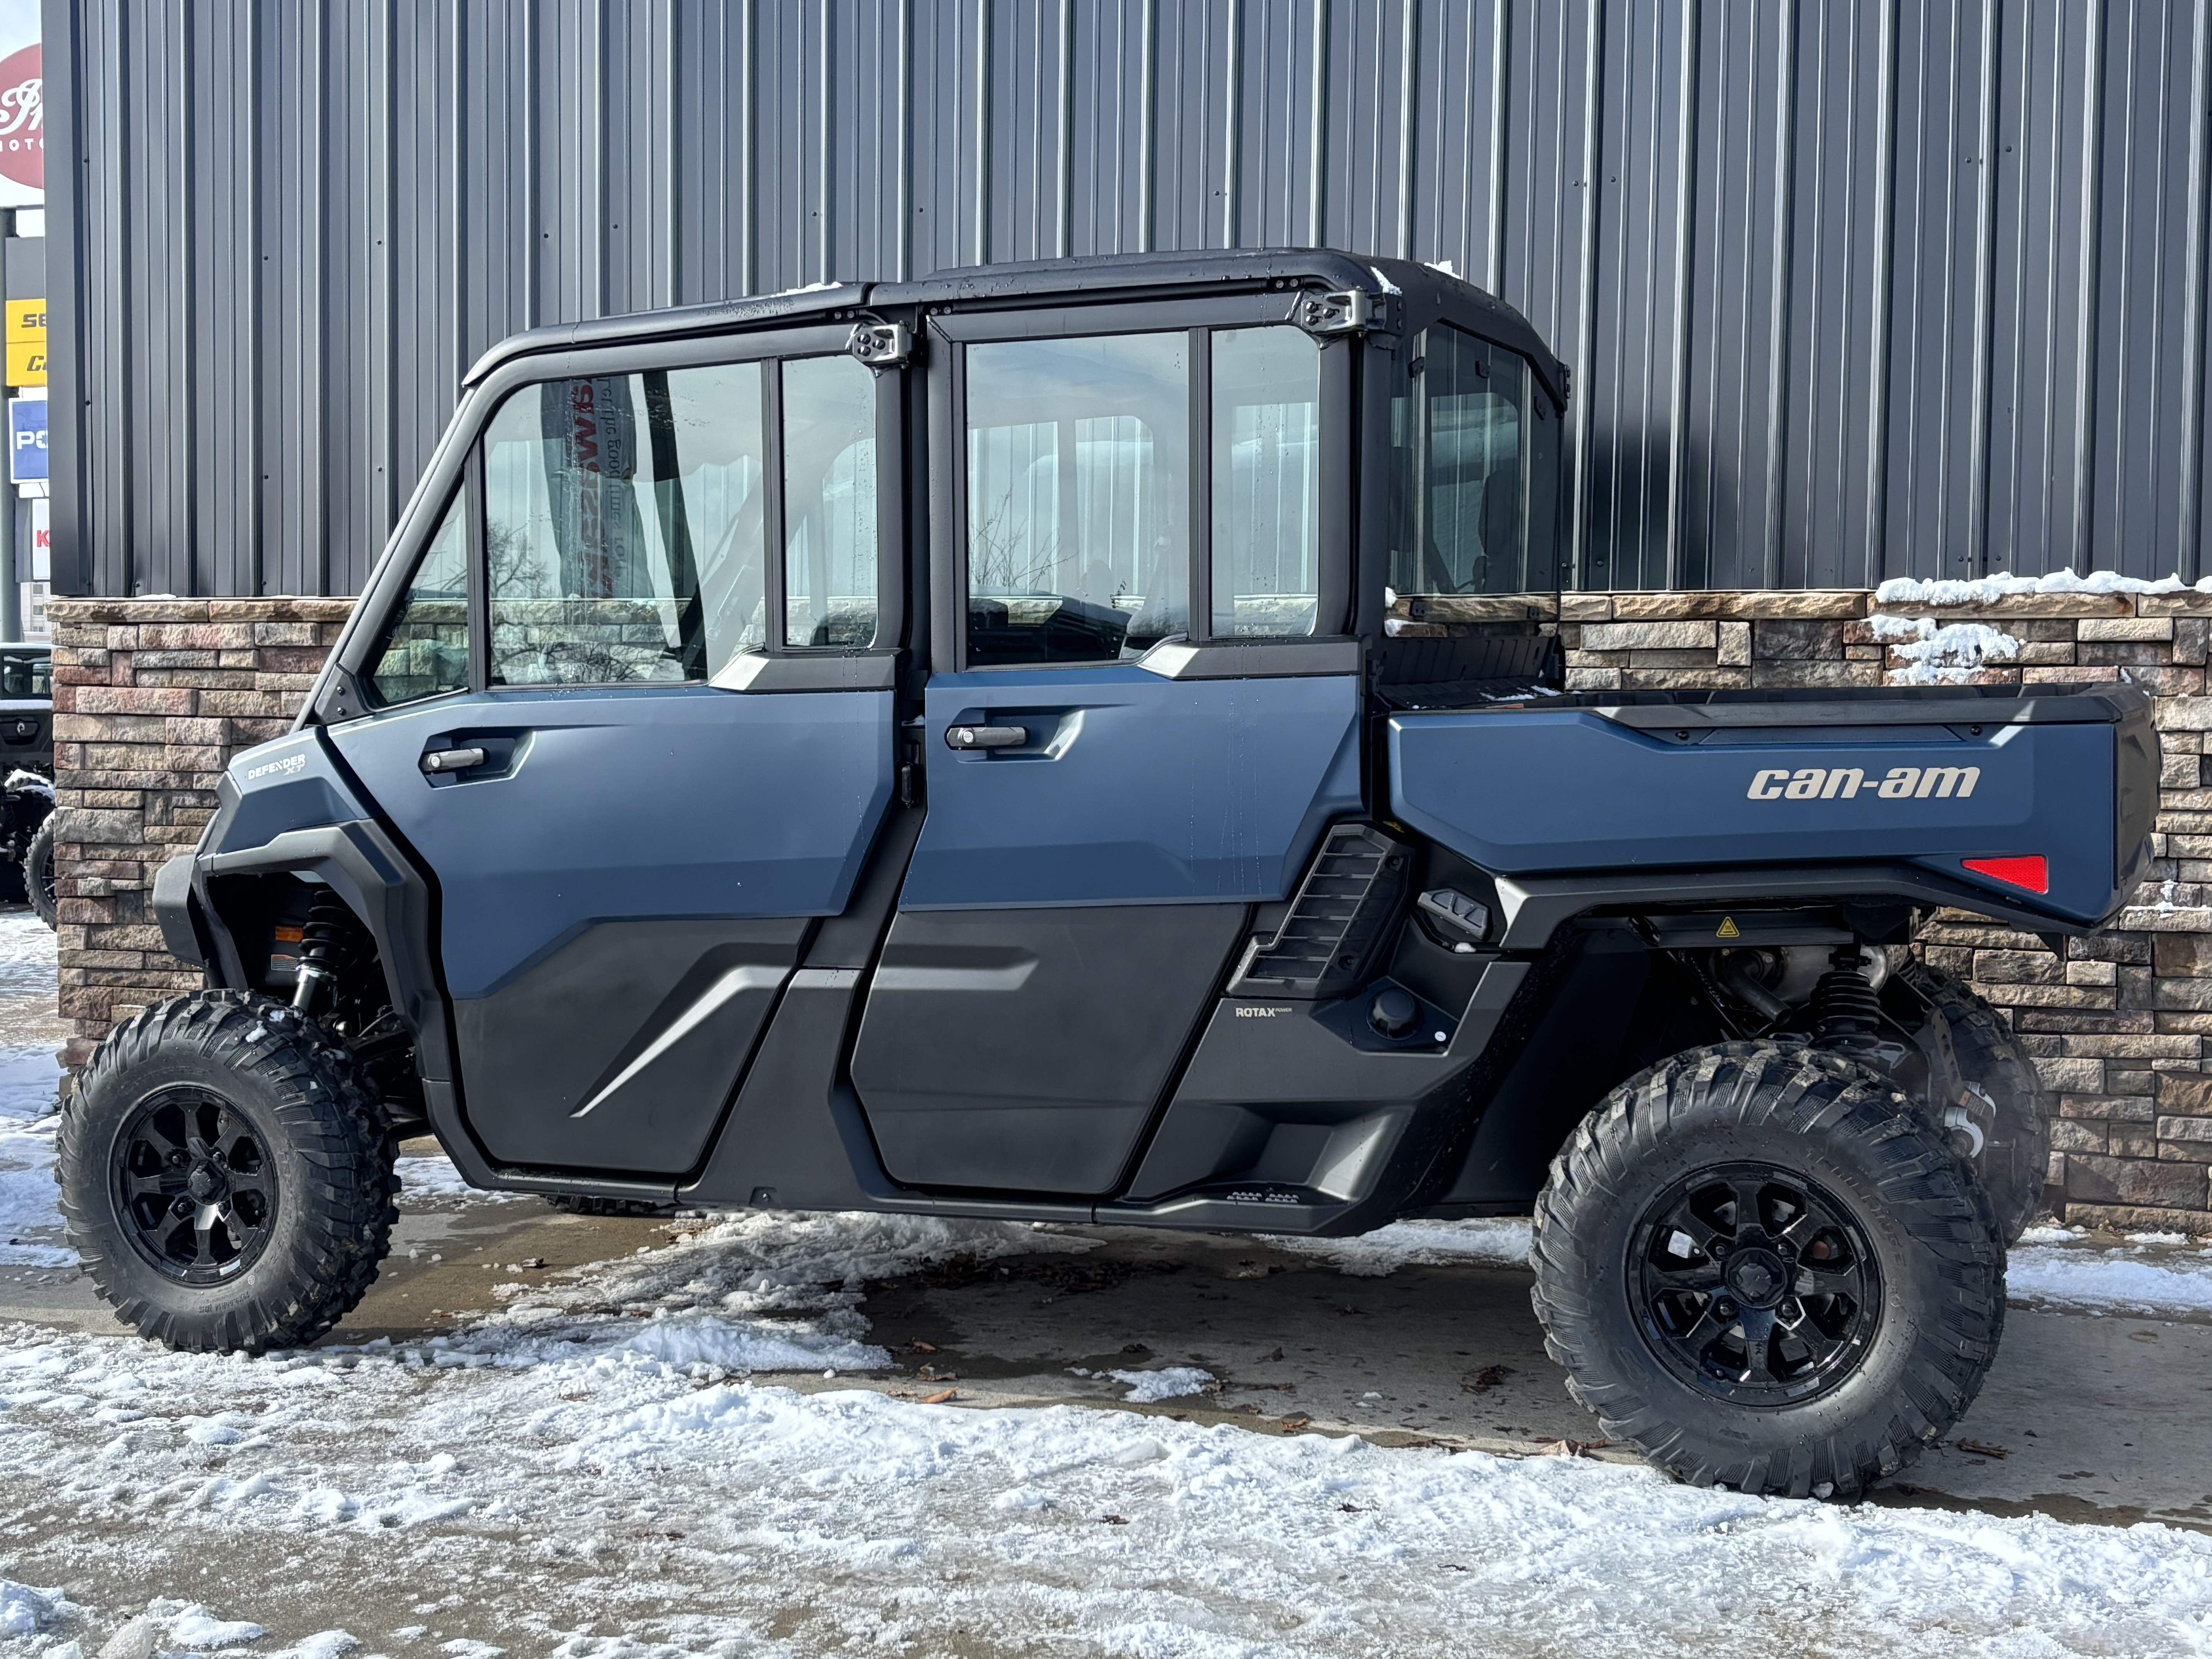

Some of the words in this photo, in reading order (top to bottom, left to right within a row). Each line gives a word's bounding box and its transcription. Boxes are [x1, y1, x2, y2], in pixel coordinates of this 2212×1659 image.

[26, 356, 47, 371] C
[248, 754, 306, 780] DEFENDER
[283, 763, 306, 776] XT
[1747, 766, 1980, 800] can-am
[1235, 1007, 1276, 1018] ROTAX
